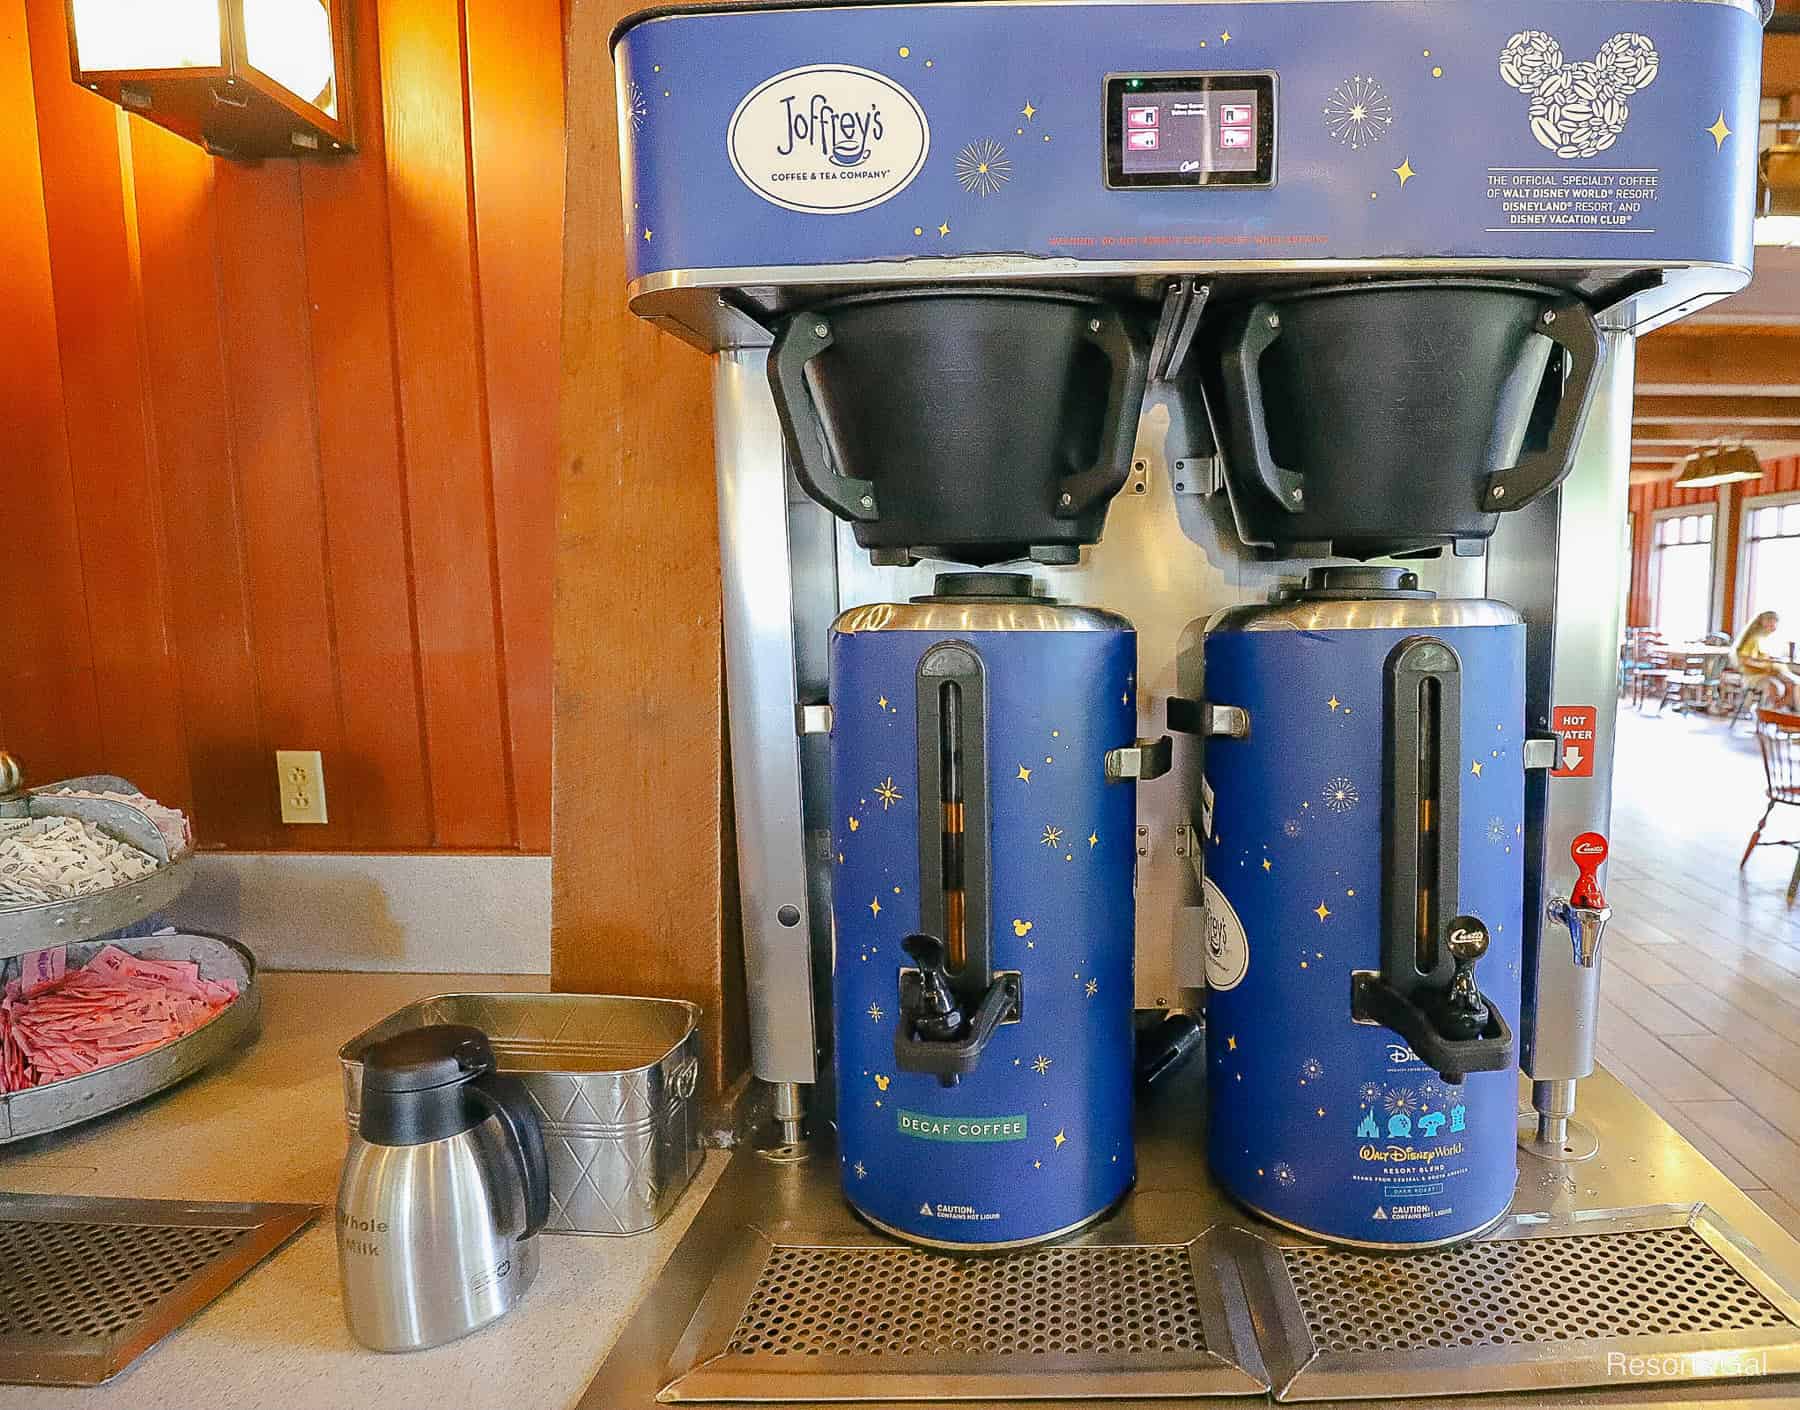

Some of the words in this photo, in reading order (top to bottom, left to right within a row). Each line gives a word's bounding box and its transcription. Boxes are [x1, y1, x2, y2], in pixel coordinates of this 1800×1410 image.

[776, 94, 884, 157] Joffrey's
[771, 172, 808, 182] COFFEE
[810, 172, 817, 181] &
[820, 172, 838, 181] TEA
[1487, 175, 1507, 185] THE
[1512, 175, 1557, 185] OFFICIAL
[1562, 175, 1615, 186] SPECIALTY
[1619, 176, 1658, 186] COFFEE
[1487, 189, 1500, 198] OF
[1503, 189, 1531, 198] WALT
[1533, 189, 1569, 198] DISNEY
[1616, 189, 1658, 200] RESORT,
[1575, 202, 1616, 213] RESORT,
[1618, 202, 1641, 211] AND
[1510, 214, 1547, 224] DISNEY
[1549, 214, 1597, 224] VACATION
[1562, 716, 1587, 726] HOT
[902, 1116, 951, 1135] DECAF
[958, 1122, 1022, 1136] COFFEE
